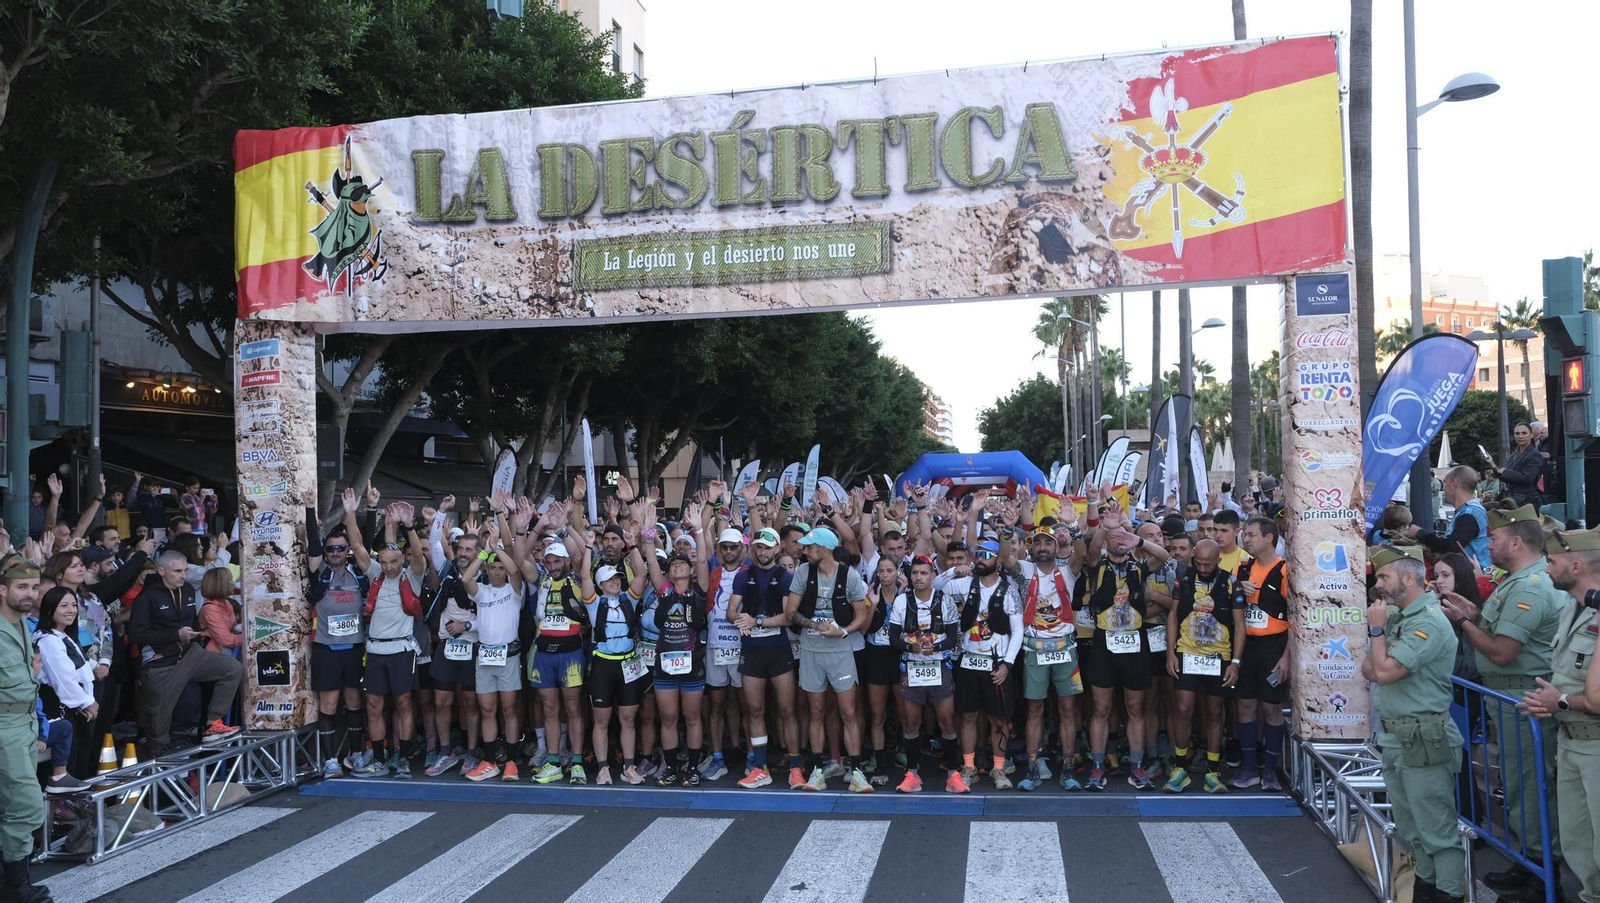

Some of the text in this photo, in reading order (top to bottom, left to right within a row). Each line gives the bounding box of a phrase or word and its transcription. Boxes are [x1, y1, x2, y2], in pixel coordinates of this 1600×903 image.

[410, 102, 1078, 221] LA DESÉRTICA
[603, 242, 856, 274] La Legión y el desierto nos une
[1297, 329, 1350, 348] Coca-Cola
[1300, 362, 1350, 370] GRUPO
[248, 375, 276, 383] MAPFRE
[1301, 371, 1351, 385] RENTA
[1301, 386, 1352, 402] TODO
[1428, 372, 1460, 415] JUEGA
[243, 449, 277, 462] BBVA
[1303, 509, 1358, 522] primaflor
[251, 527, 282, 535] HYUNDAI
[255, 561, 284, 574] Sabor
[1309, 608, 1362, 623] unica
[336, 620, 355, 629] 3800
[1114, 635, 1136, 645] 5423
[483, 650, 503, 658] 2064
[720, 649, 740, 657] 3475
[1045, 652, 1066, 662] 5497
[670, 658, 685, 667] 703
[968, 658, 988, 668] 5495
[1193, 656, 1216, 666] 5422
[915, 668, 937, 678] 5498
[257, 700, 292, 711] Almería
